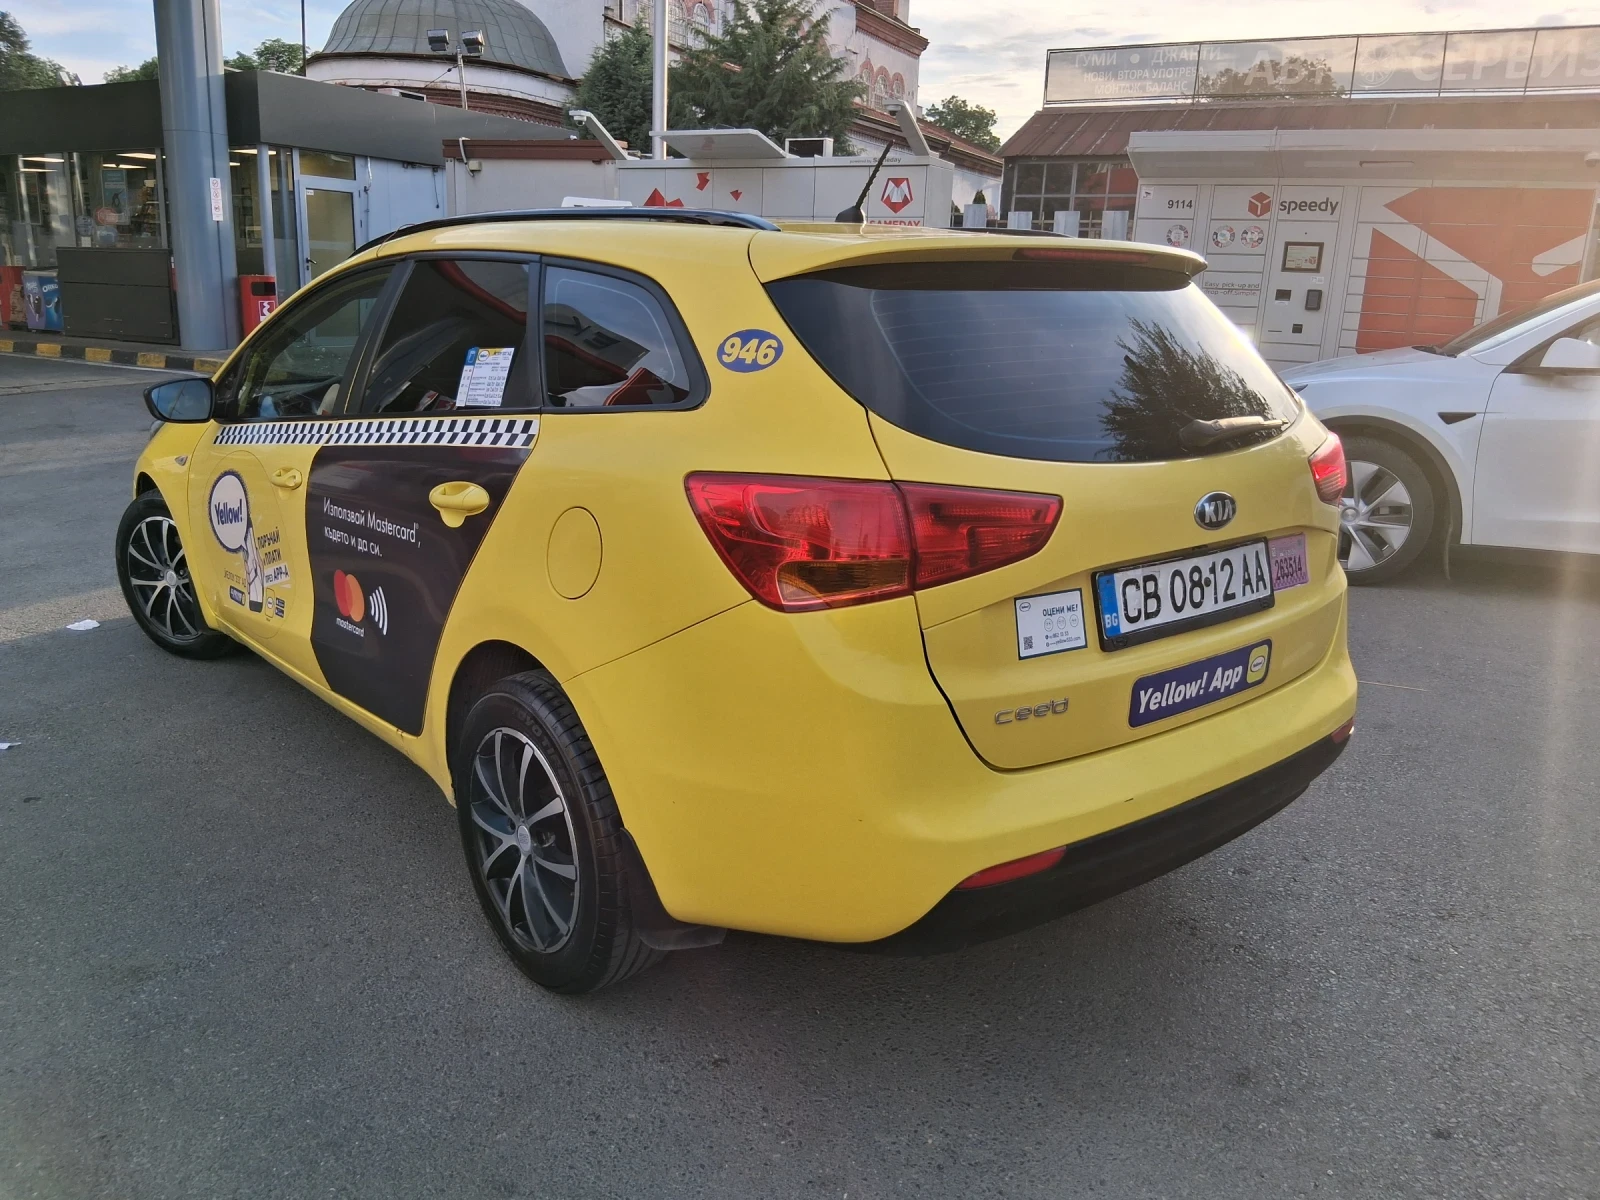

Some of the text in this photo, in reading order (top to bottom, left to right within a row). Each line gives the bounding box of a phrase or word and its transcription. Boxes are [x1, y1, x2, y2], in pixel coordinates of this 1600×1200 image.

[1074, 46, 1221, 67] ГУМИ ДЖАНТИ
[1084, 71, 1115, 83] НОВИ,
[1117, 69, 1149, 80] ВТОРА
[1146, 80, 1188, 92] БАЛАНС
[1167, 200, 1193, 209] 9114
[1279, 197, 1339, 215] speedy
[1204, 281, 1220, 289] Easy
[722, 336, 778, 365] 946
[214, 498, 243, 526] Yellow!
[323, 497, 365, 527] Използвай
[1203, 499, 1233, 524] KIA
[324, 526, 383, 557] където и да си.
[1241, 550, 1267, 597] AA
[1274, 555, 1304, 581] 263514
[1042, 603, 1079, 617] ОЦЕНИ МЕ!
[1104, 613, 1119, 628] BG
[335, 617, 365, 637] mastercard
[1139, 665, 1243, 714] Yellow! App
